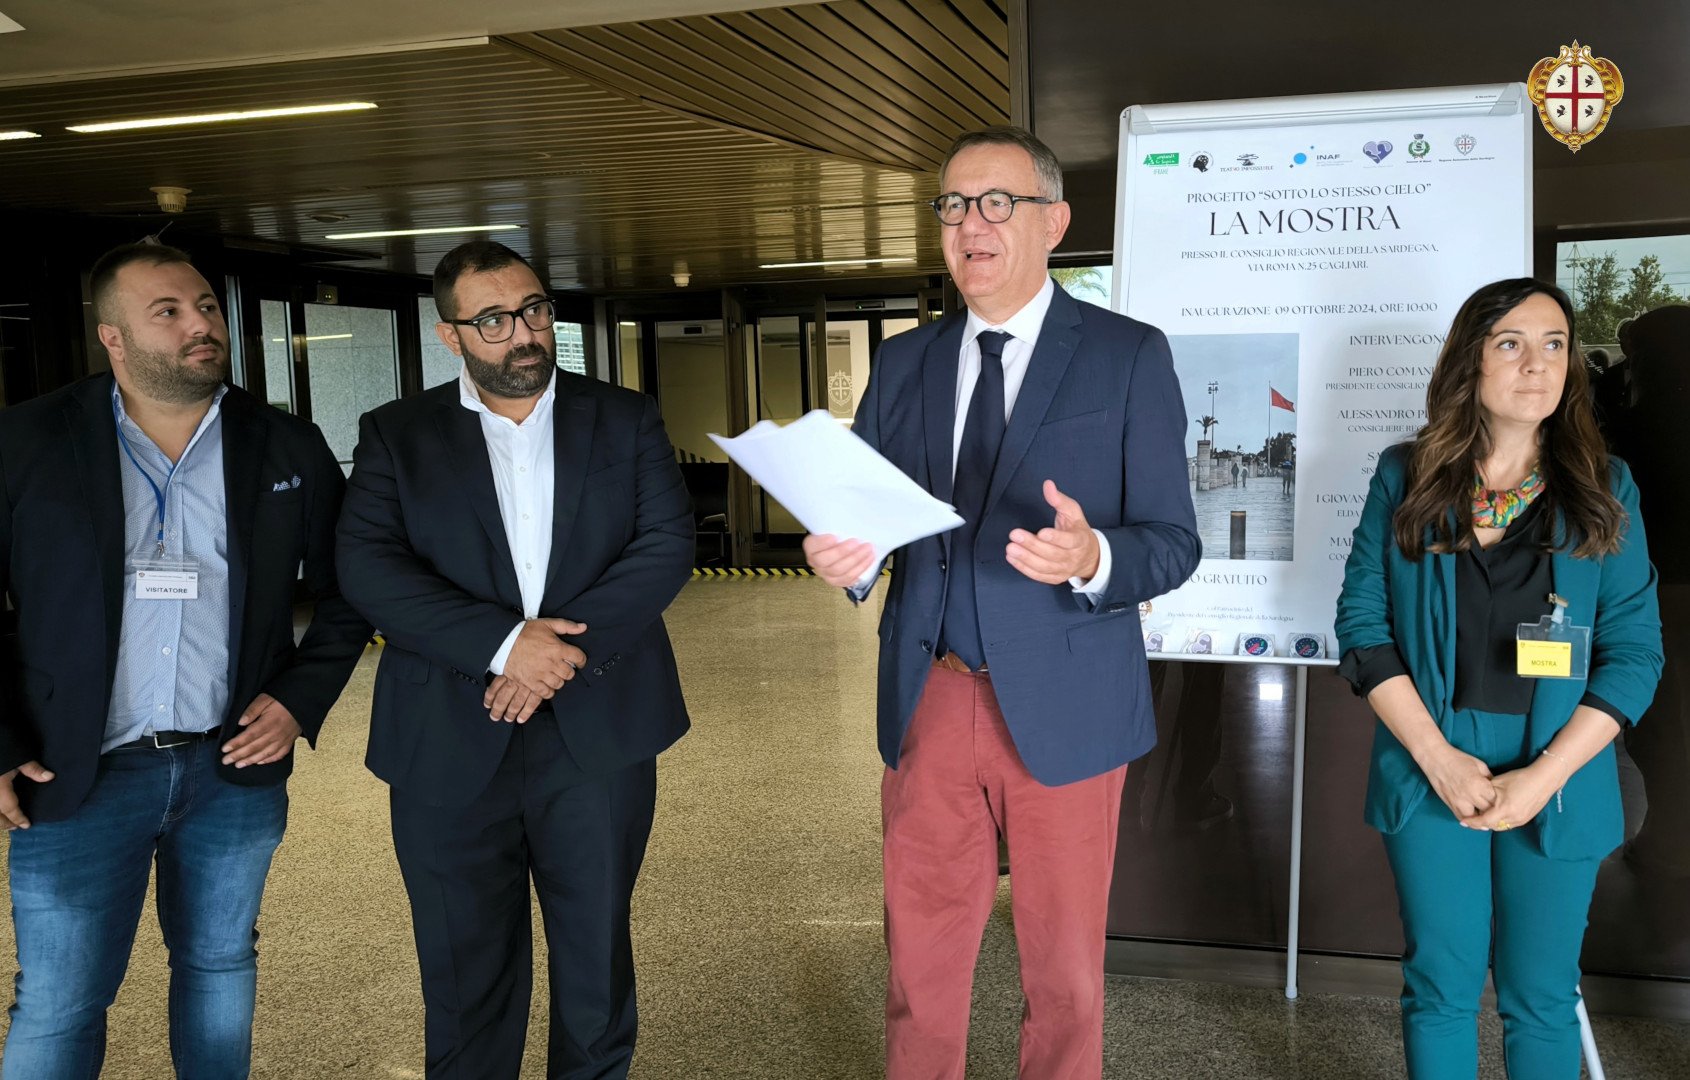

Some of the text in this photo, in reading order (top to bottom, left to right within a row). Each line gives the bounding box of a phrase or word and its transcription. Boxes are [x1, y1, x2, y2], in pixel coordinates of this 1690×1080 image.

[1187, 190, 1256, 203] PROGETTO
[1311, 187, 1329, 198] LO
[1332, 185, 1382, 197] STESSO
[1210, 205, 1401, 236] LA MOSTRA
[1181, 250, 1218, 259] PRESSO
[1220, 250, 1228, 258] IL
[1230, 248, 1286, 258] CONSIGLIO
[1287, 246, 1345, 257] REGIONALE
[1346, 245, 1379, 255] DELLA
[1248, 263, 1264, 271] VIA
[1266, 262, 1296, 271] ROMA
[1297, 261, 1317, 271] N.25
[1181, 302, 1438, 317] INAUGURAZIONE 09 OTTOBRE 2024, ORE 10:00
[1349, 367, 1384, 376] PIERO
[1325, 382, 1376, 390] PRESIDENTE
[1376, 382, 1425, 390] CONSIGLIO
[1337, 409, 1415, 419] ALESSANDRO
[1347, 424, 1405, 433] CONSIGLIERE
[1203, 573, 1268, 585] GRATUITO
[1531, 659, 1558, 667] MOSTRA
